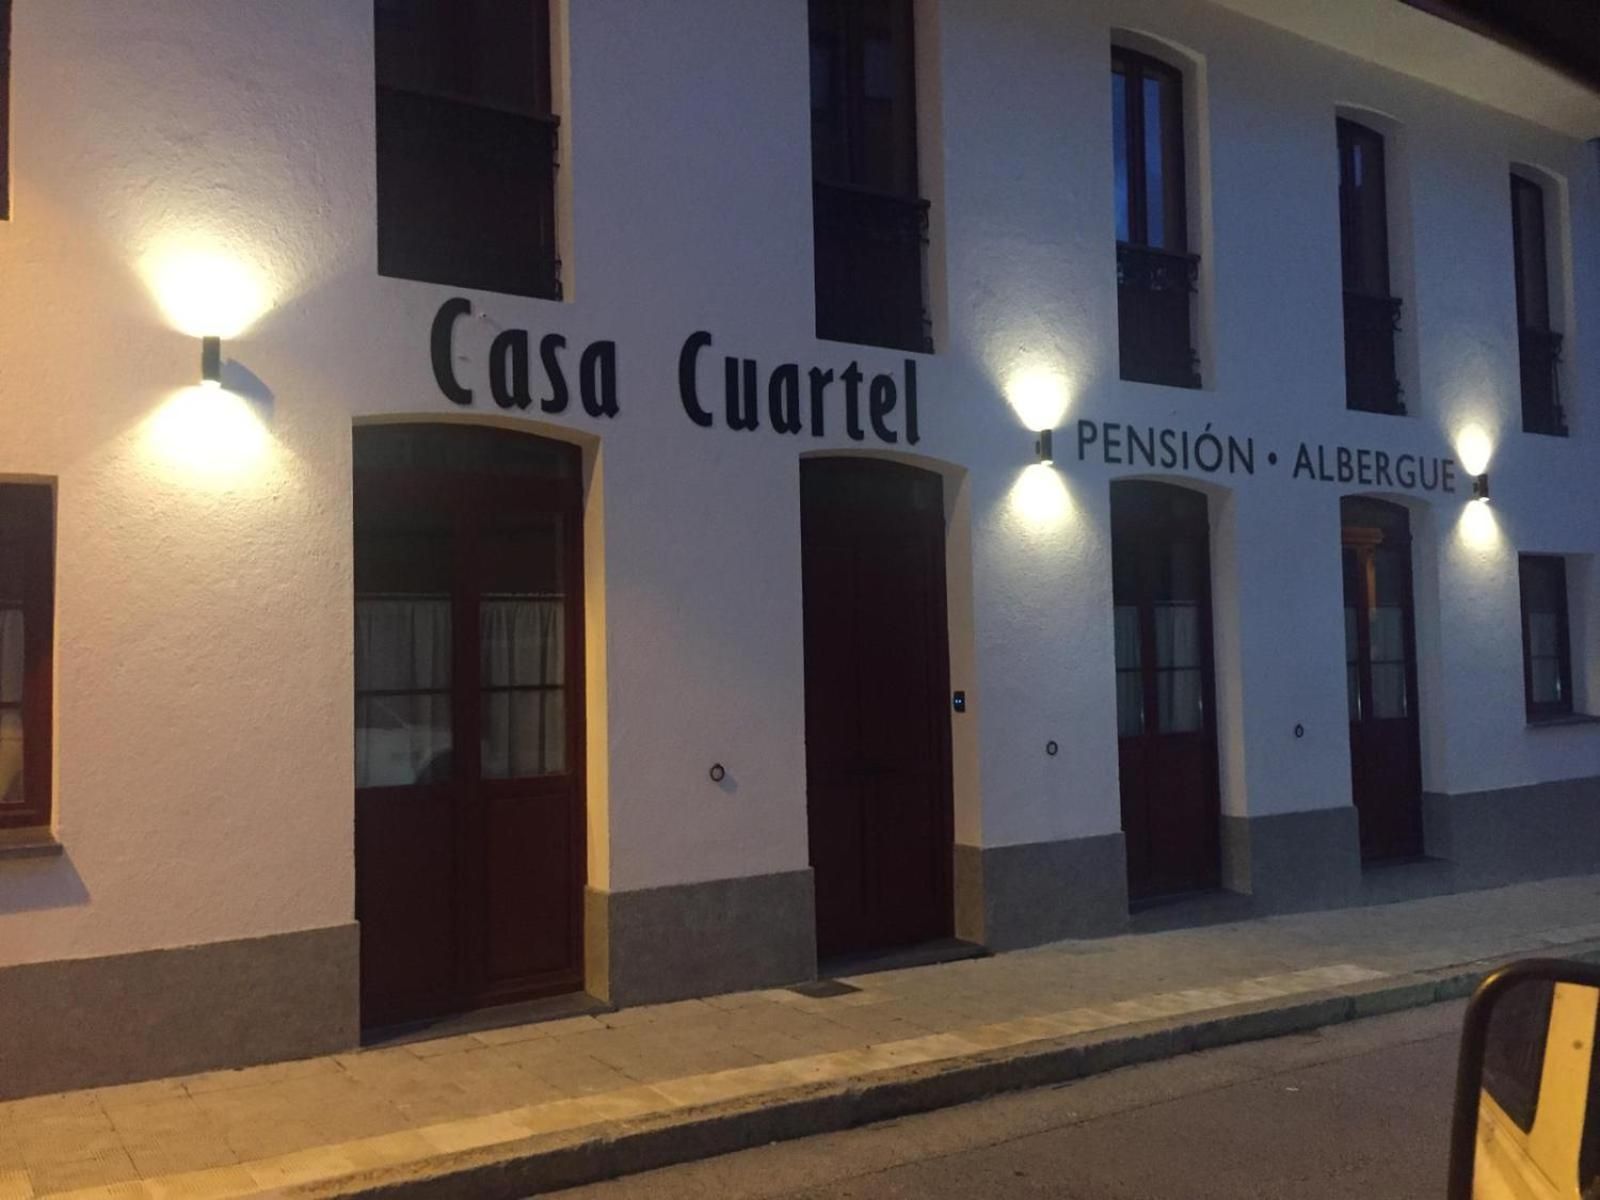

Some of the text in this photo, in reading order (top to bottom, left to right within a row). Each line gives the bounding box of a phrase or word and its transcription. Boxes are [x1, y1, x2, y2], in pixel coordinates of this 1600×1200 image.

[430, 297, 920, 446] Casa Cuartel
[1077, 420, 1456, 493] PENSIÓN ALBERGUE
